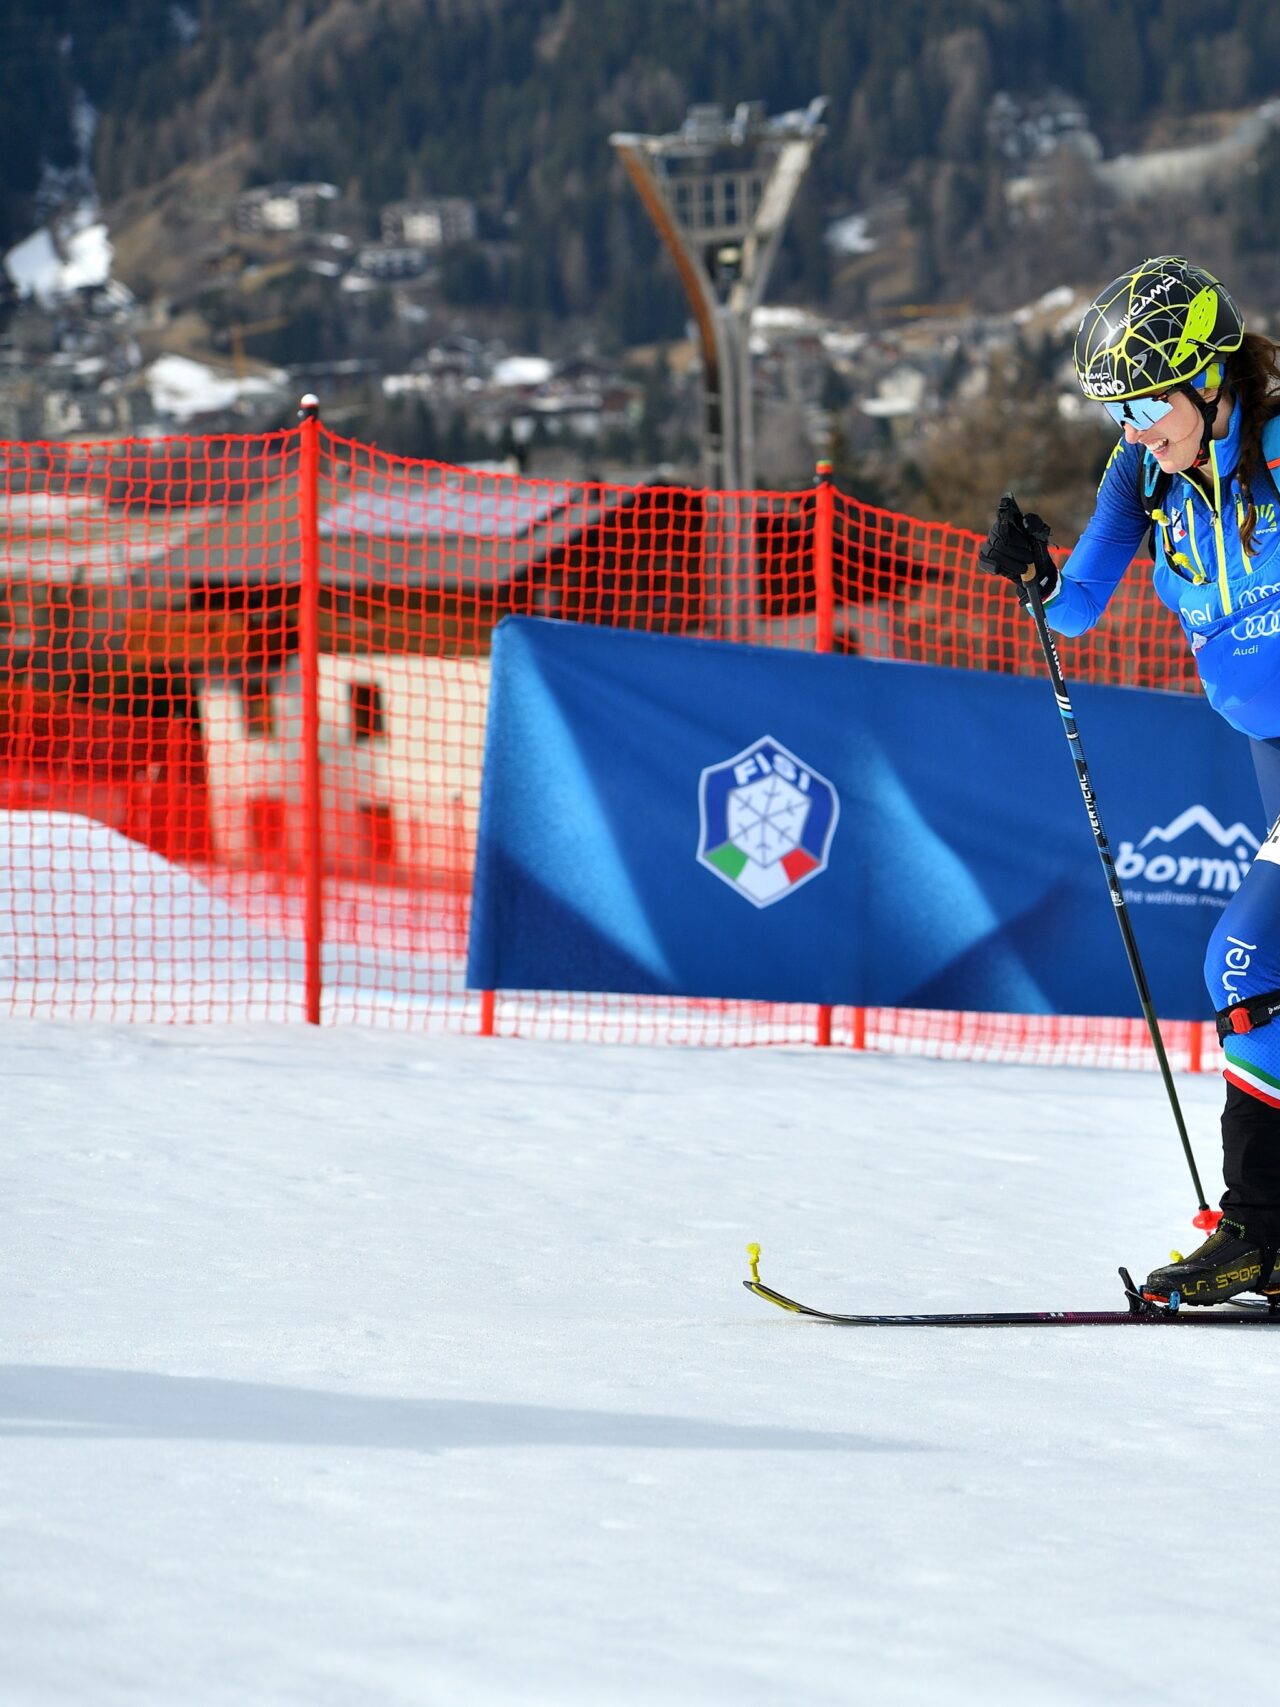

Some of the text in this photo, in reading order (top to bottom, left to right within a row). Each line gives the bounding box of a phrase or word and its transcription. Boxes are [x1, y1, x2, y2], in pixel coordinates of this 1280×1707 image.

[1180, 603, 1212, 626] nel
[1232, 645, 1259, 656] Audi
[733, 752, 811, 791] FISI
[1081, 774, 1101, 836] VERTICAL
[1114, 841, 1252, 891] bormi
[1145, 889, 1197, 906] wellness
